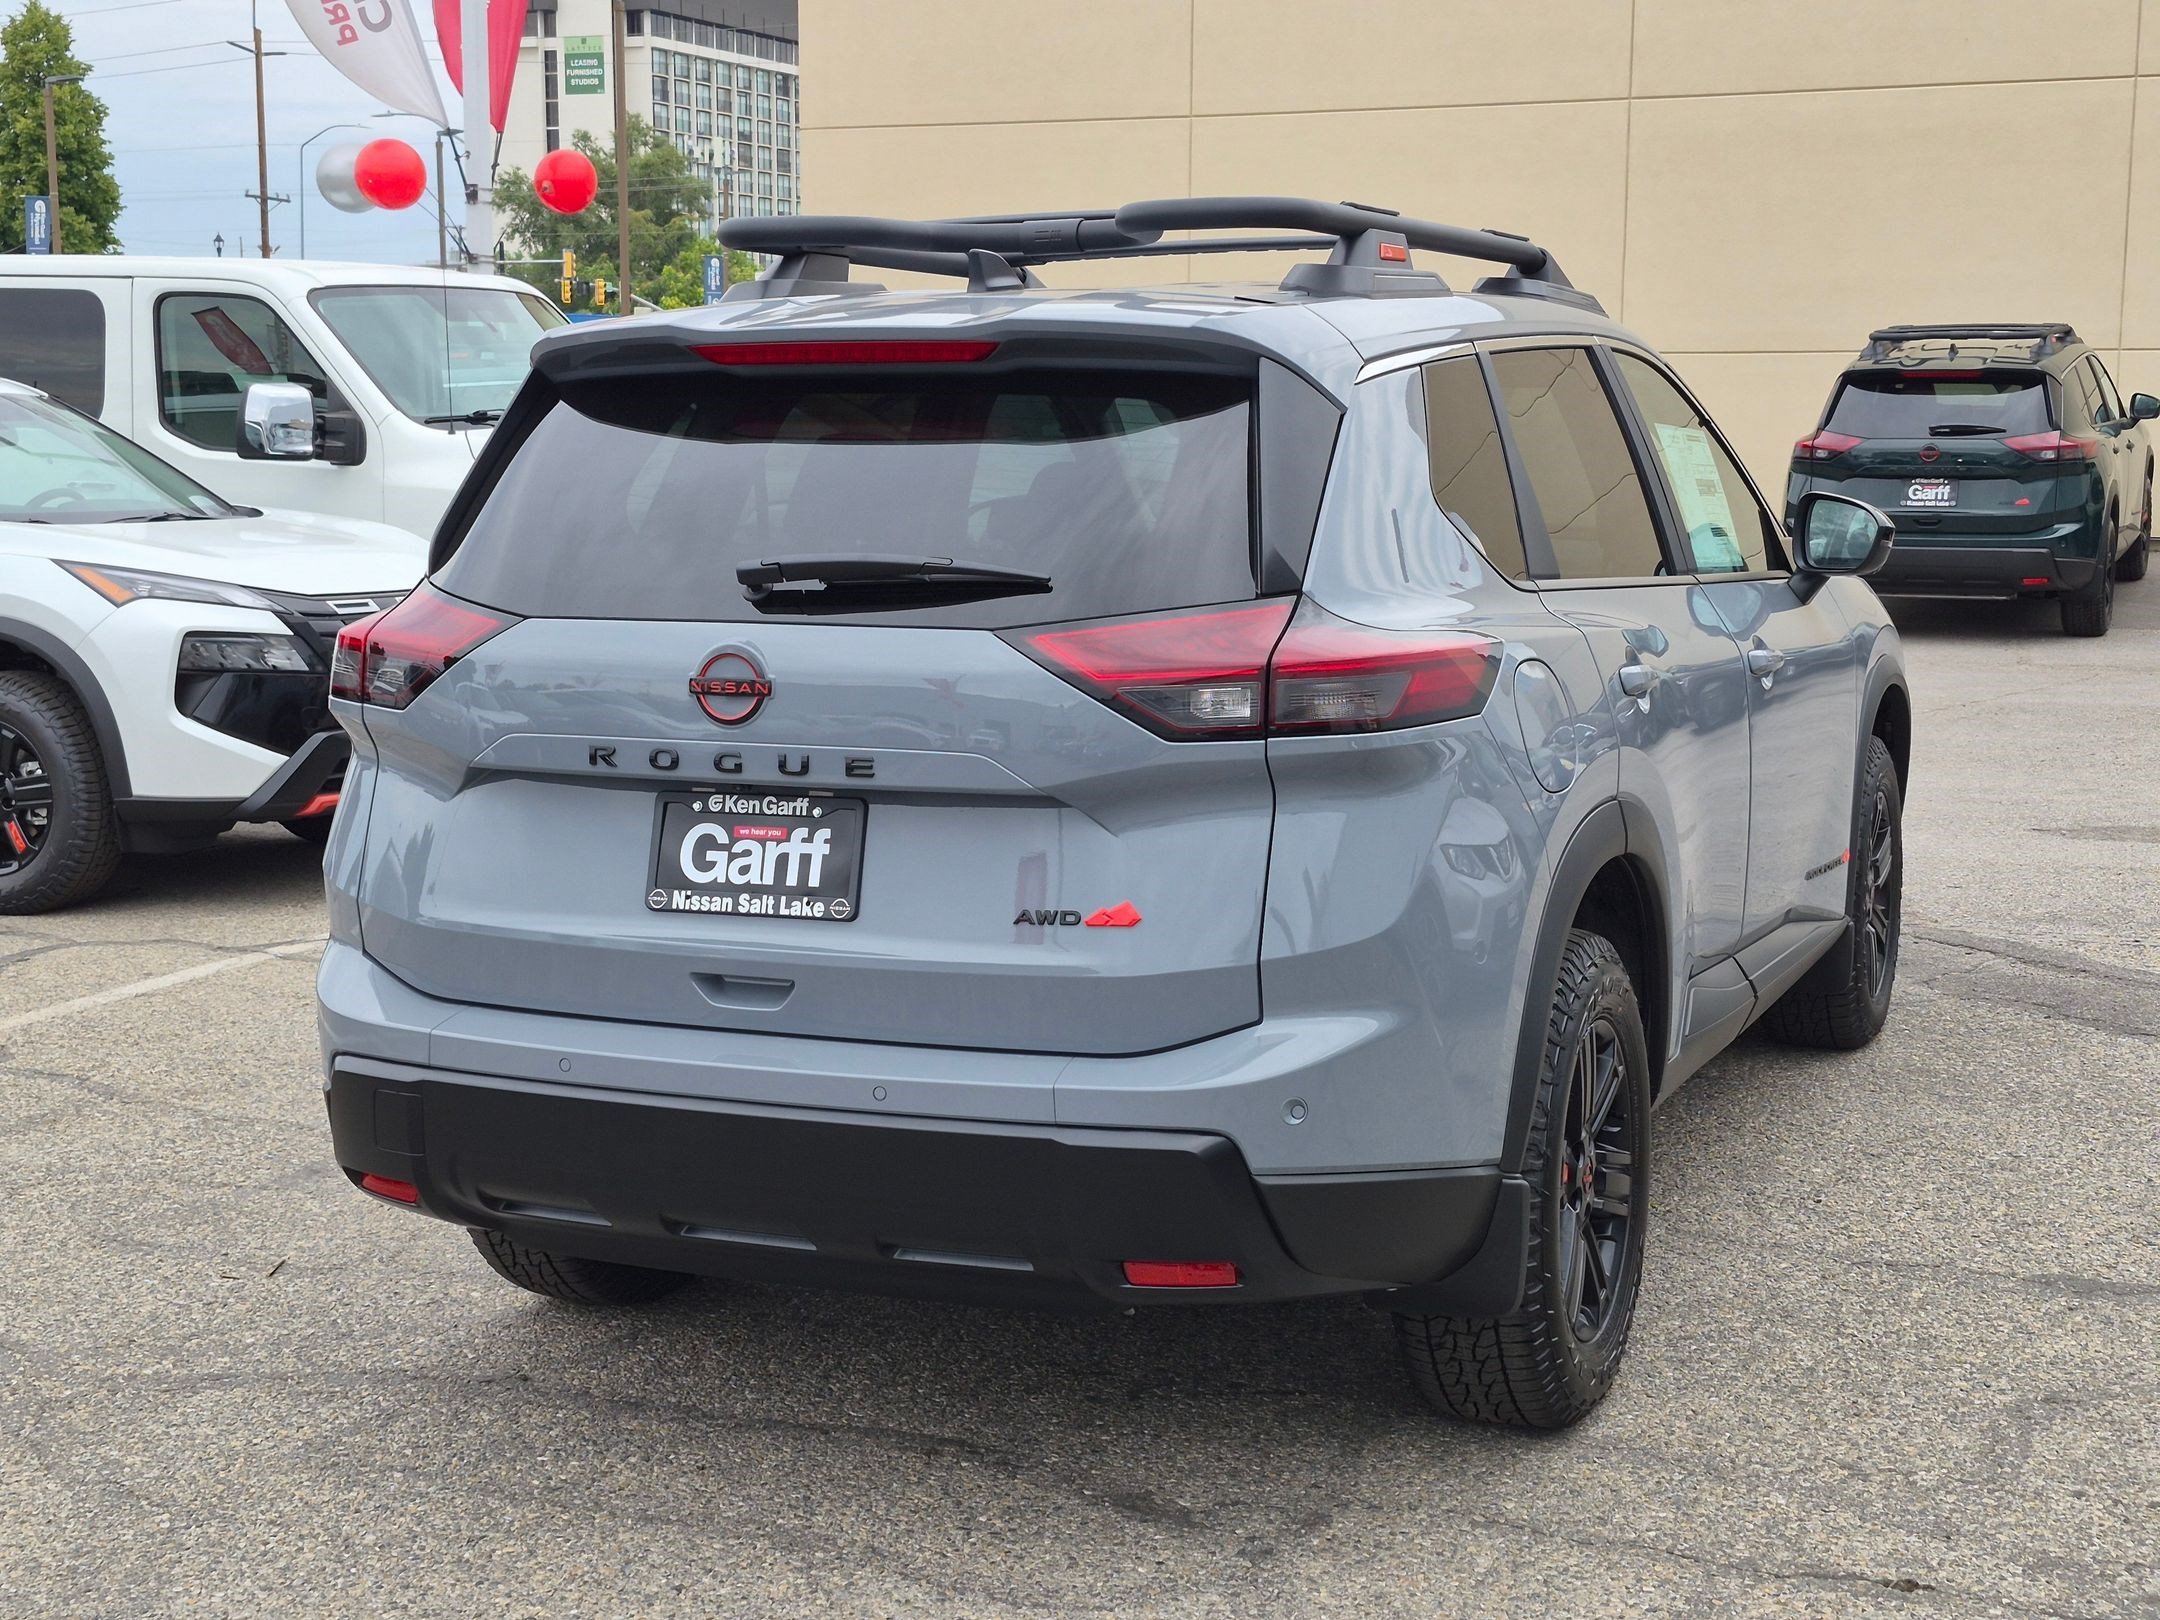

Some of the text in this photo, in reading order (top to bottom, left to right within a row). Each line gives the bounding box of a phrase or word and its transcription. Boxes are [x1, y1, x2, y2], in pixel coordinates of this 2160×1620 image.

[570, 59, 599, 67] LEASING
[570, 78, 599, 86] STUDIOS
[1908, 484, 1951, 500] Garff
[690, 680, 770, 696] NISSAN
[588, 744, 876, 778] ROGUE
[725, 795, 810, 816] Ken Garff
[767, 829, 781, 837] you
[679, 822, 832, 888] Garff
[671, 890, 825, 917] Nissan Salt Lake
[1013, 909, 1082, 926] AWD
